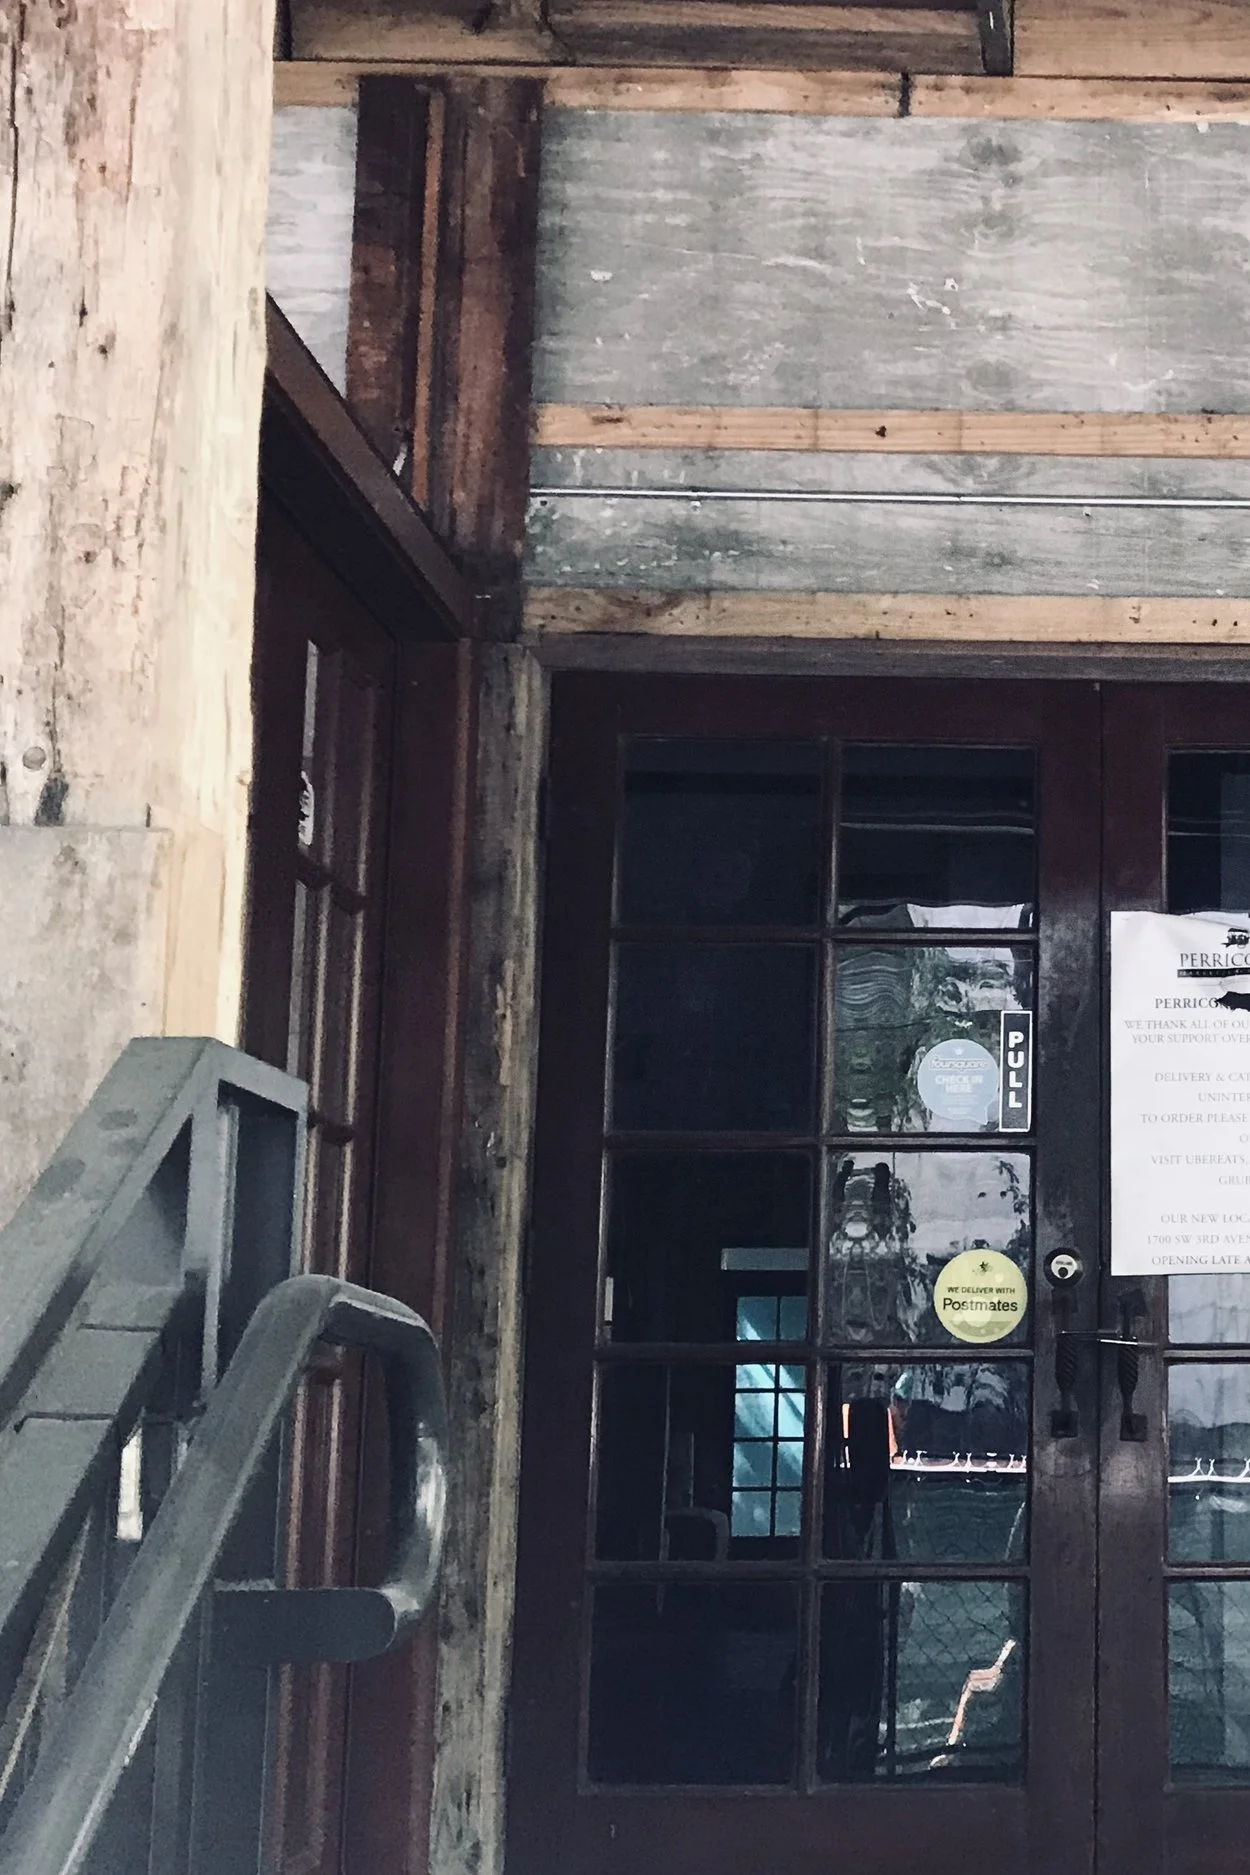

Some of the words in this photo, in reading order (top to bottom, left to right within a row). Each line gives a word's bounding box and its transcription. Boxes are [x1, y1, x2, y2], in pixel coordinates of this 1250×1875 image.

[1125, 1020, 1145, 1029] WE
[1147, 1020, 1188, 1030] THANK
[1190, 1020, 1210, 1029] ALL
[1214, 1020, 1229, 1029] OF
[1132, 1034, 1165, 1043] YOUR
[1167, 1034, 1218, 1043] SUPPORT
[1007, 1031, 1024, 1108] PULL
[1154, 1072, 1211, 1082] DELIVERY
[1216, 1072, 1225, 1082] &
[1140, 1113, 1158, 1123] TO
[1160, 1113, 1204, 1123] ORDER
[1206, 1113, 1249, 1123] PLEASE
[1151, 1154, 1182, 1165] VISIT
[1160, 1214, 1188, 1223] OUR
[1191, 1214, 1219, 1223] NEW
[1147, 1235, 1172, 1244] 1700
[1174, 1235, 1191, 1245] SW
[1196, 1235, 1220, 1245] 3RD
[1151, 1255, 1209, 1265] OPENING
[1211, 1255, 1241, 1265] LATE
[947, 1286, 959, 1294] WE
[961, 1286, 993, 1294] DELIVER
[943, 1297, 1018, 1311] Postmates
